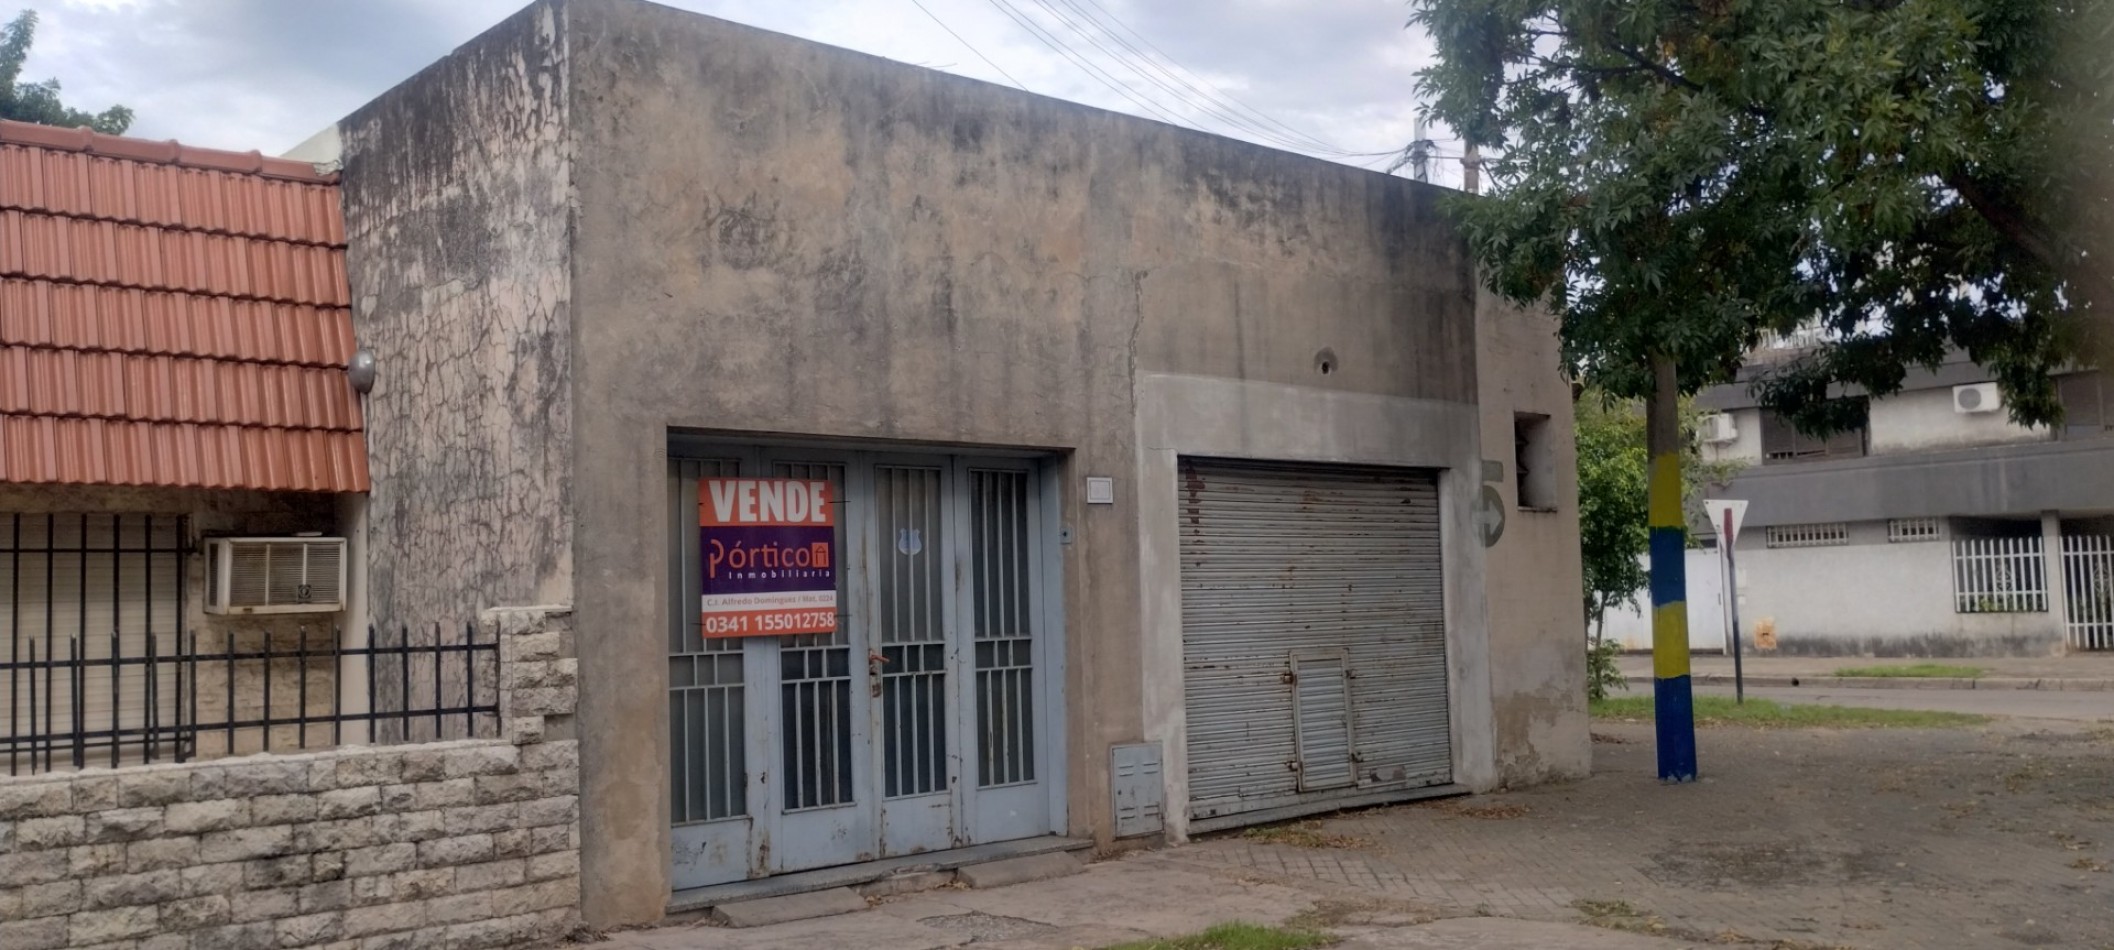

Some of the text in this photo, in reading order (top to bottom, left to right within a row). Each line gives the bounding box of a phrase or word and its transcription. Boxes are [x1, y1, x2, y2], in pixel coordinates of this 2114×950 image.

[708, 479, 827, 523] VENDE
[709, 538, 811, 579] Pórtico
[728, 569, 830, 580] Inmobiliaria
[722, 597, 753, 606] Alfredo
[706, 611, 835, 633] 0341 155012758
